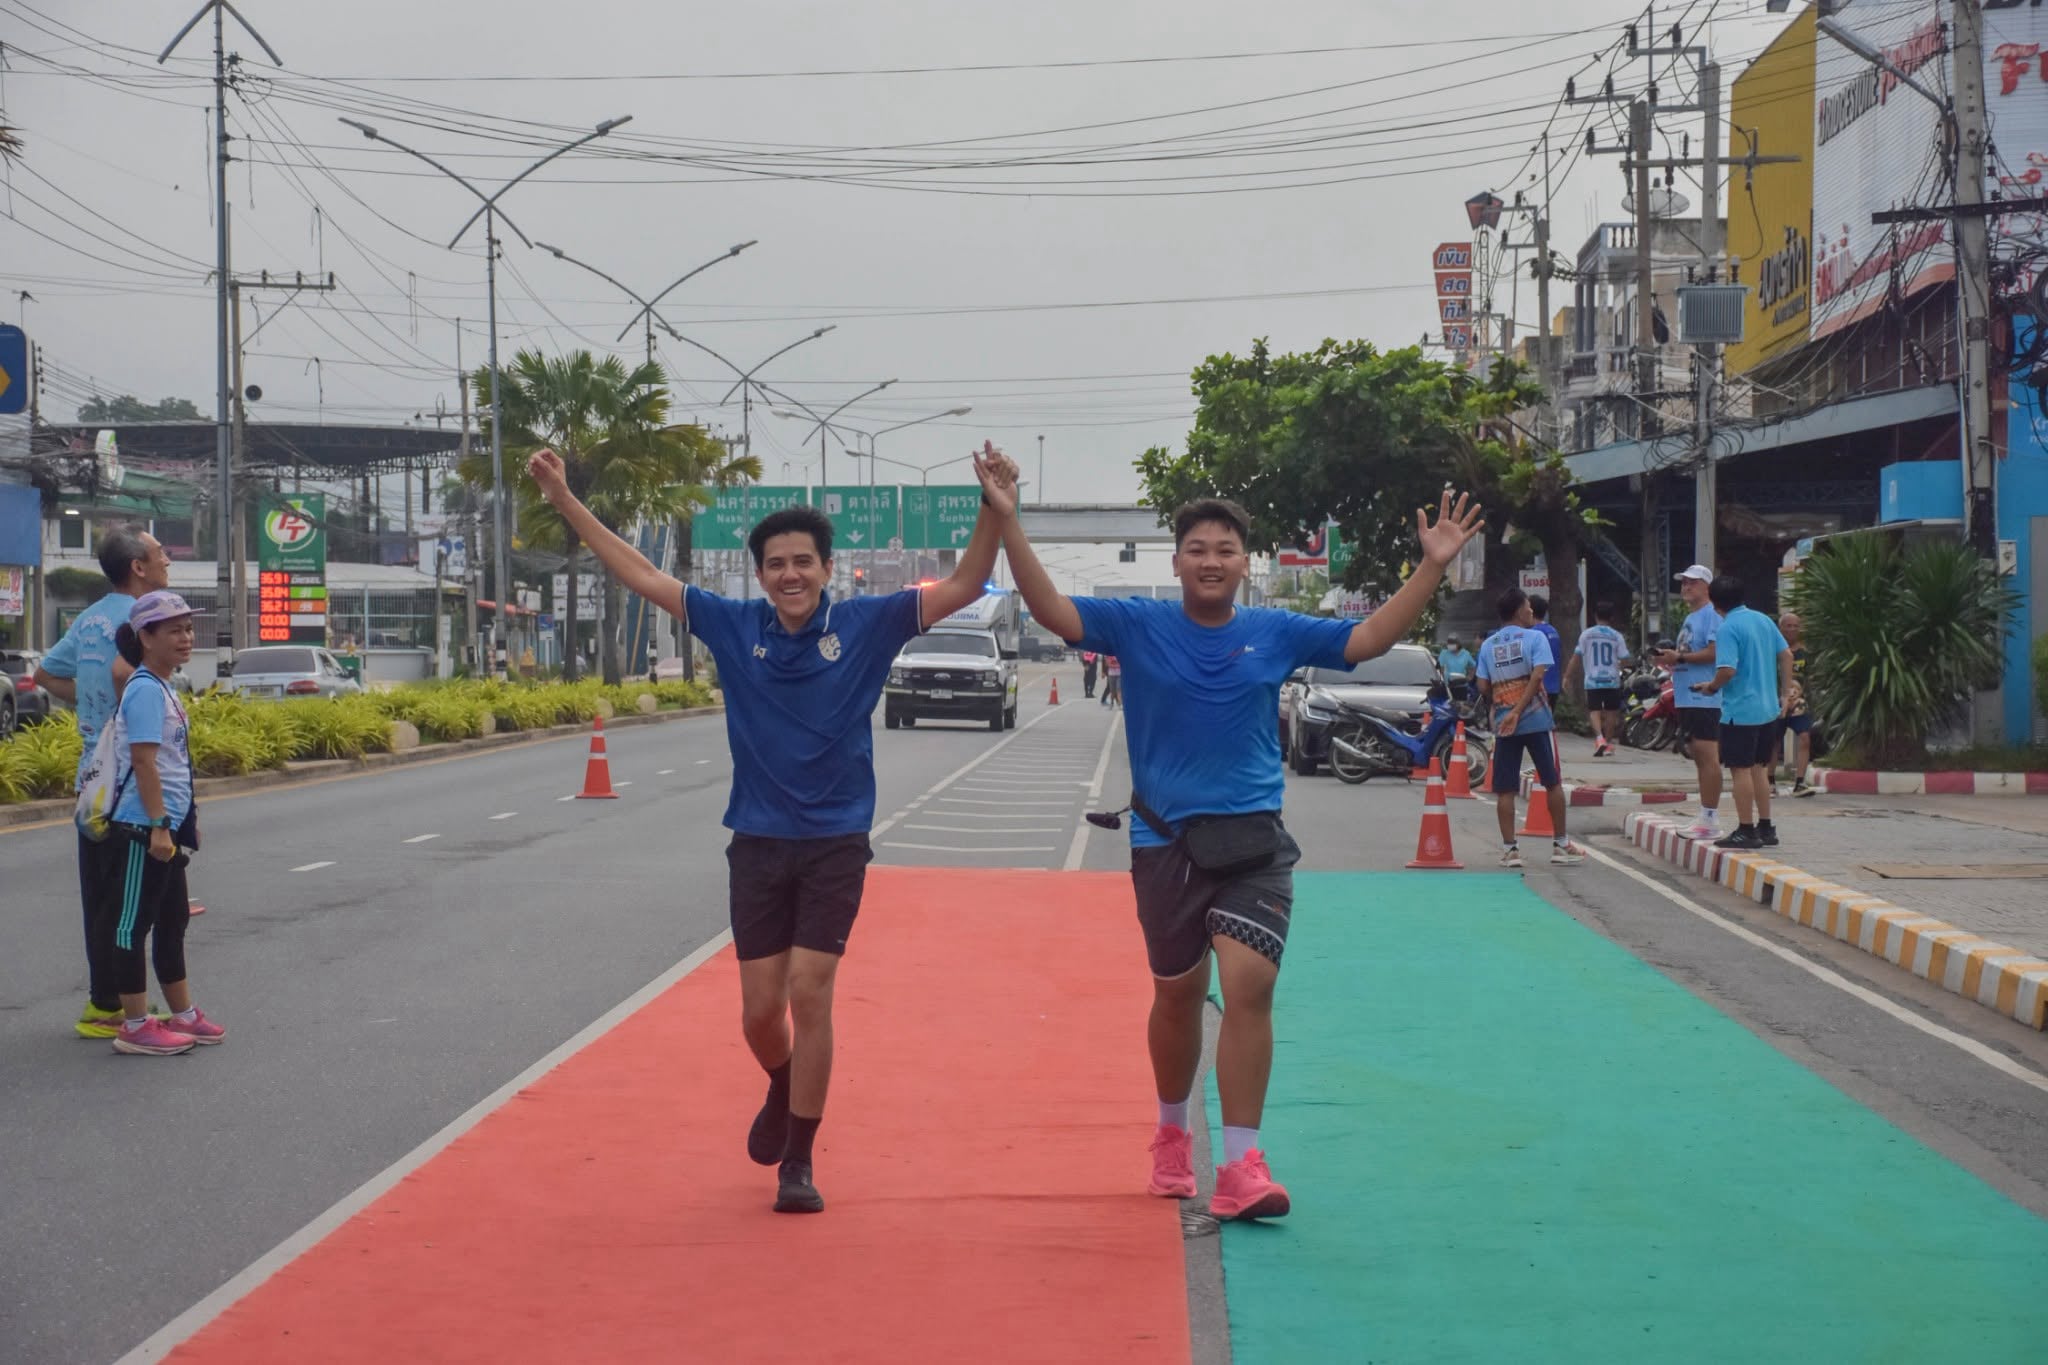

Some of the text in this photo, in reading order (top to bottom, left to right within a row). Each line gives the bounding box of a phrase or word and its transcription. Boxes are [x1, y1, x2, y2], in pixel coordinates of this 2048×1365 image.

[1438, 248, 1468, 265] เงิน
[1443, 278, 1467, 292] สด
[1591, 642, 1612, 667] 10
